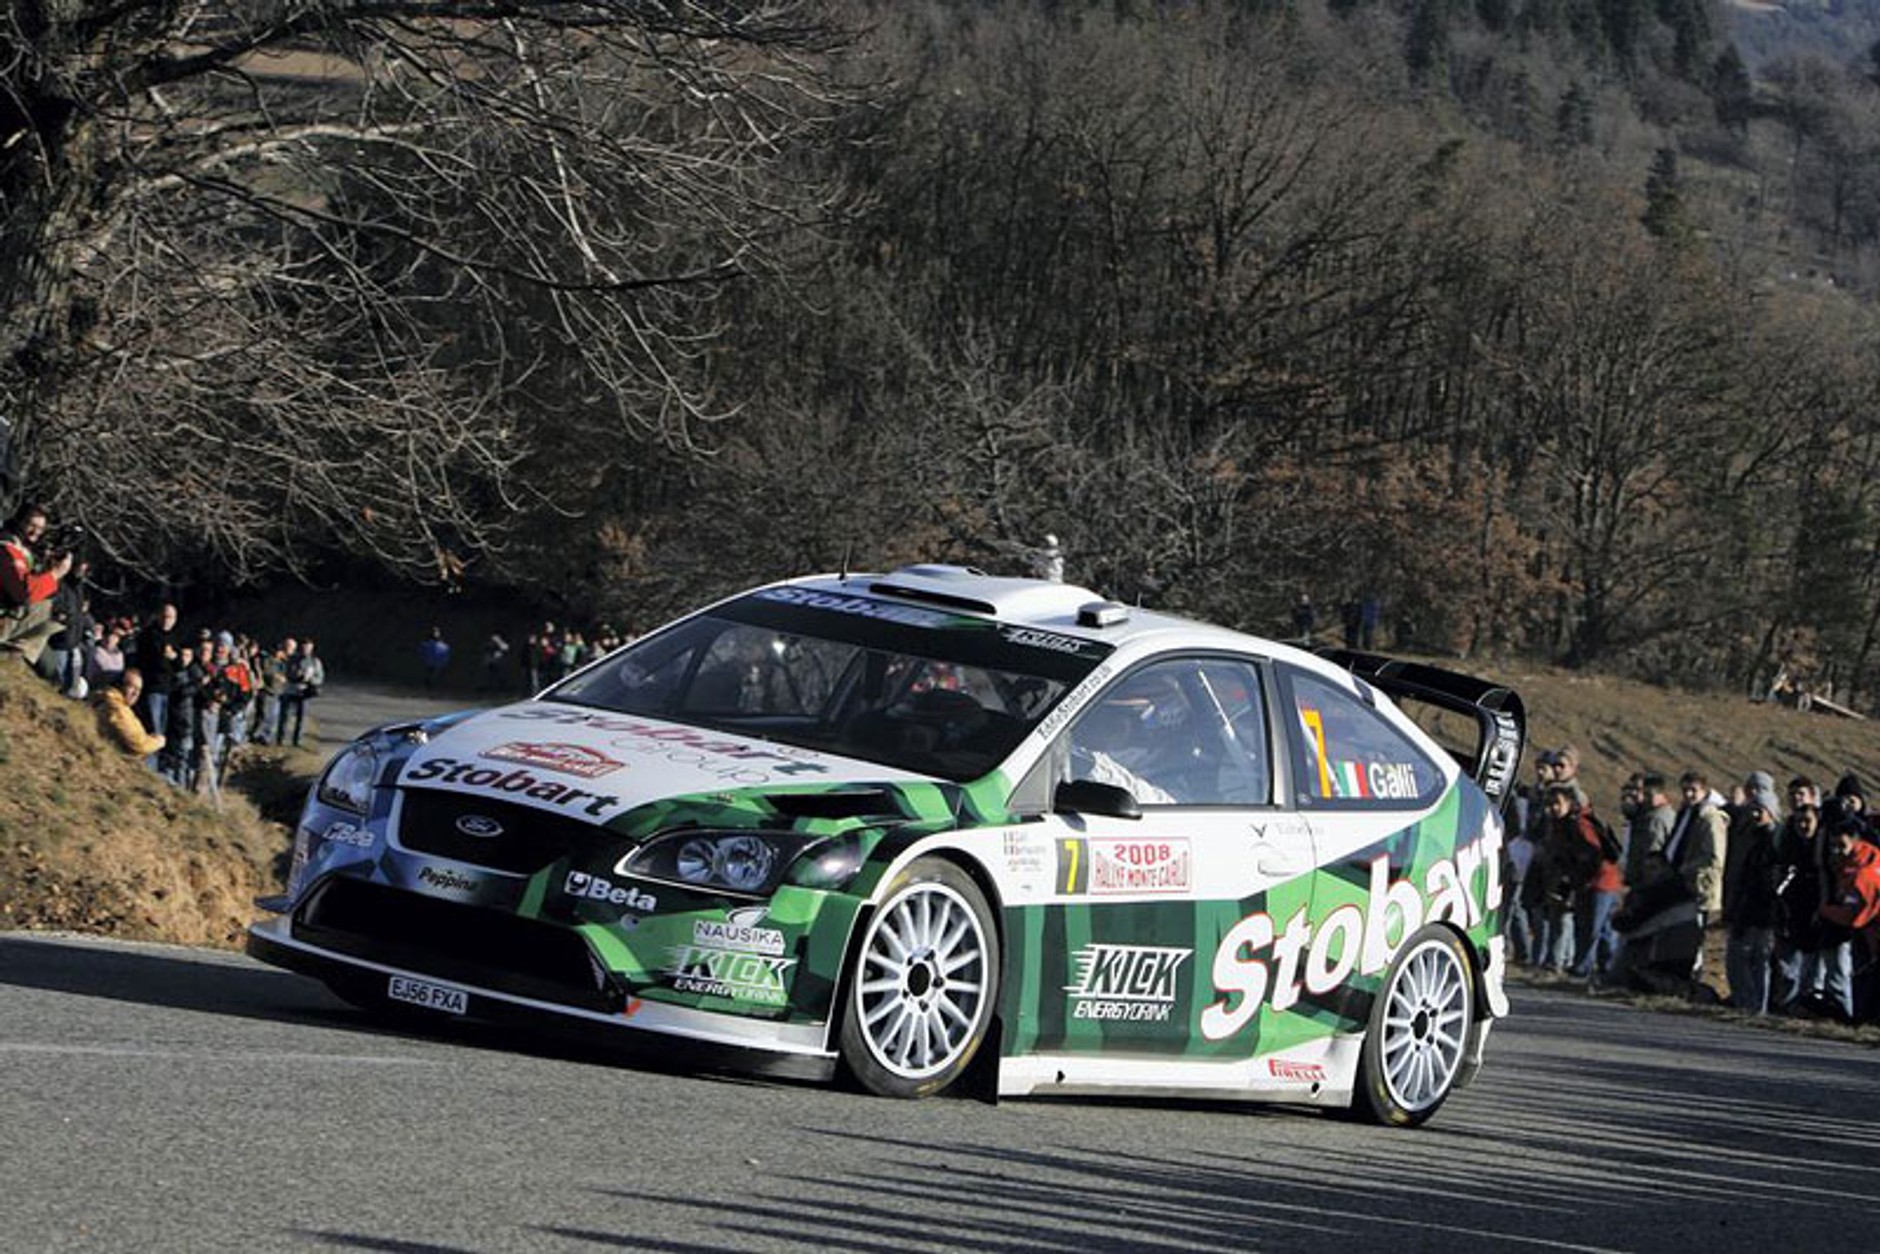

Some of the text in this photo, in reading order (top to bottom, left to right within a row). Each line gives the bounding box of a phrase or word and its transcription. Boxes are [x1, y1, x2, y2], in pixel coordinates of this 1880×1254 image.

[1302, 709, 1332, 799] 7
[407, 757, 620, 816] Stobart
[1368, 759, 1418, 799] Galli
[1063, 839, 1080, 893] 7
[1114, 843, 1171, 866] 2008
[588, 875, 657, 912] Beta
[695, 921, 783, 945] NAUSIKA
[1200, 810, 1503, 1040] Stobart
[1078, 945, 1194, 1001] KICK
[392, 979, 463, 1011] EJ56 FXA
[1268, 1058, 1327, 1081] PIRELLI
